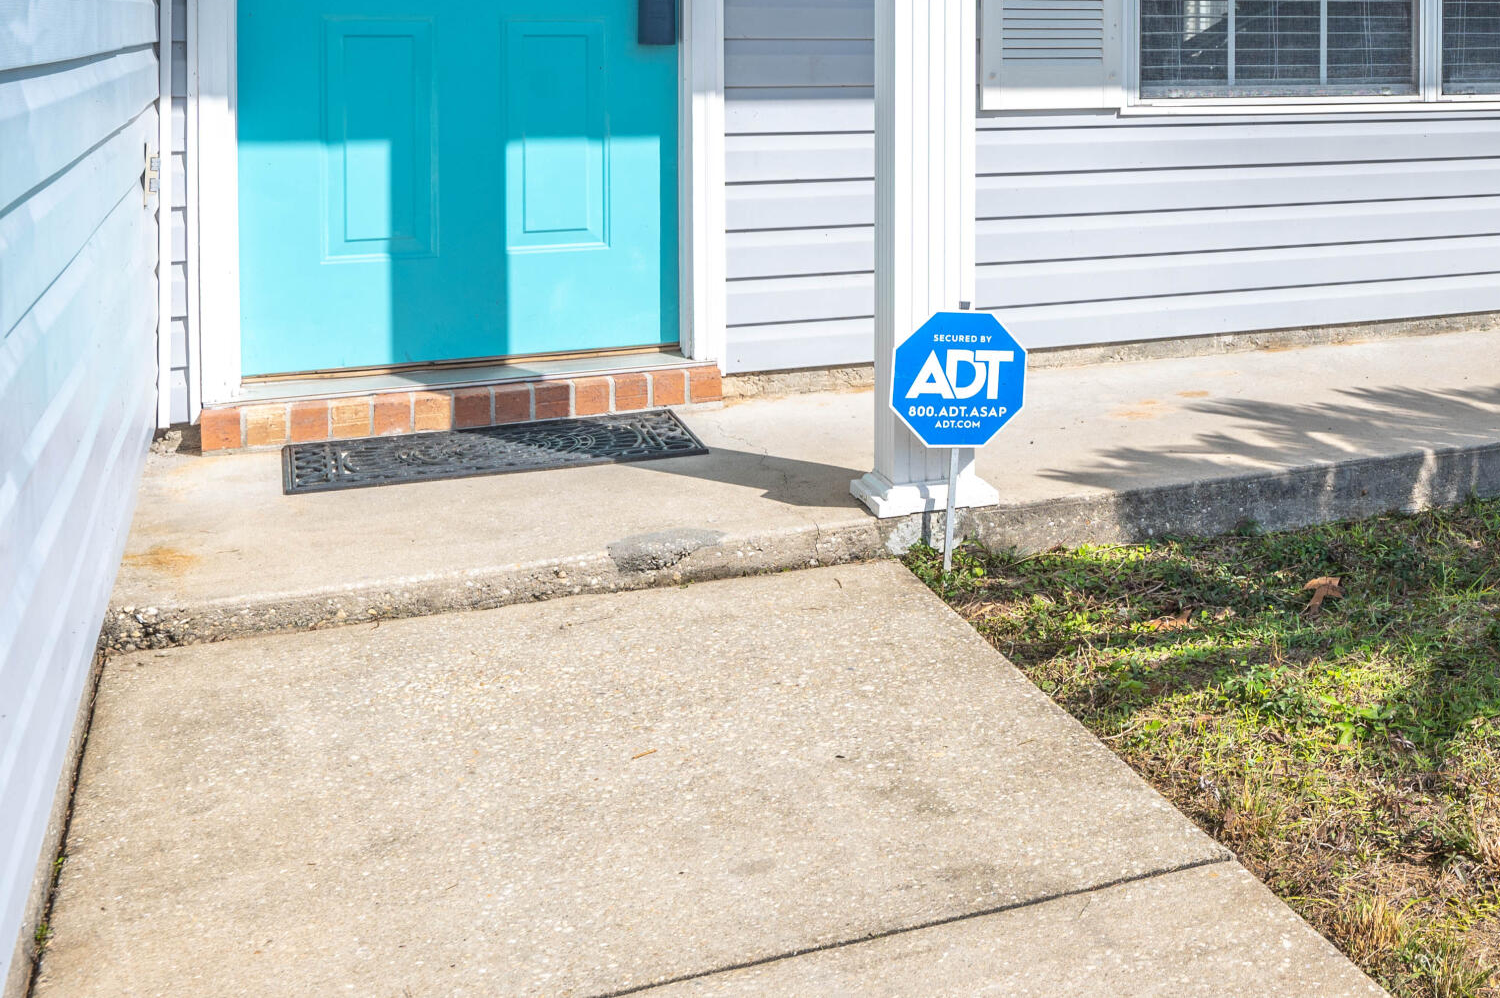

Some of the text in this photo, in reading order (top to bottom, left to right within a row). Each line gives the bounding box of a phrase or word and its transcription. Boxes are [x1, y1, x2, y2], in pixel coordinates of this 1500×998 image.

[933, 334, 993, 343] SECURED BY
[904, 349, 1015, 400] ADT
[908, 405, 1008, 418] 800.ADT.ASAP
[934, 420, 981, 429] ADT.COM
